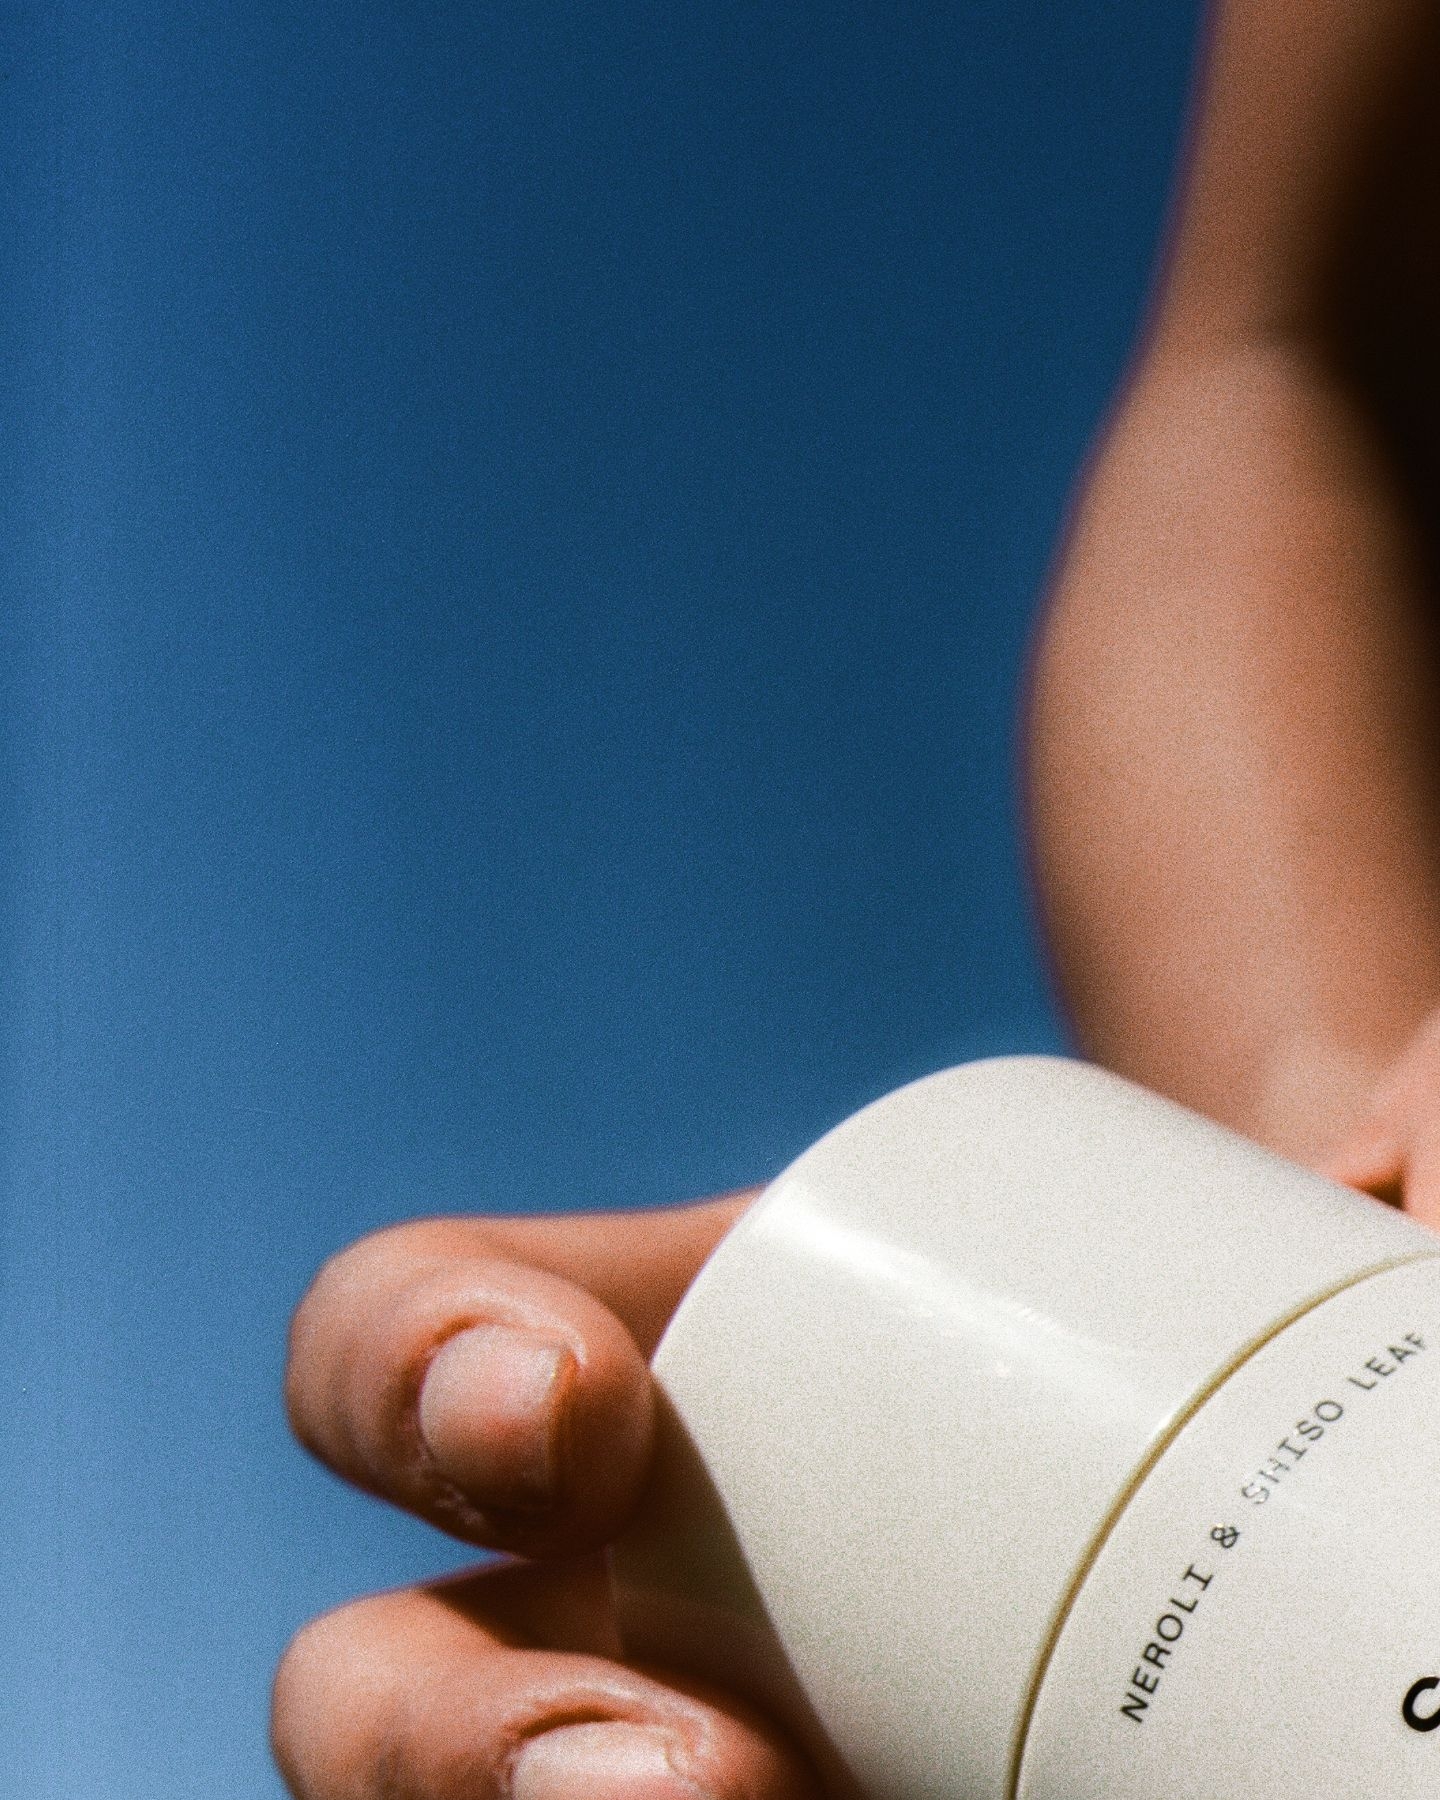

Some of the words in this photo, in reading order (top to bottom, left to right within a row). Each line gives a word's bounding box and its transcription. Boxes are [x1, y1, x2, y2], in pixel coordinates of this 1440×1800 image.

[1119, 1563, 1215, 1723] NEROLI
[1209, 1524, 1241, 1549] &
[1241, 1399, 1345, 1505] SHISO
[1346, 1330, 1426, 1391] LEAF
